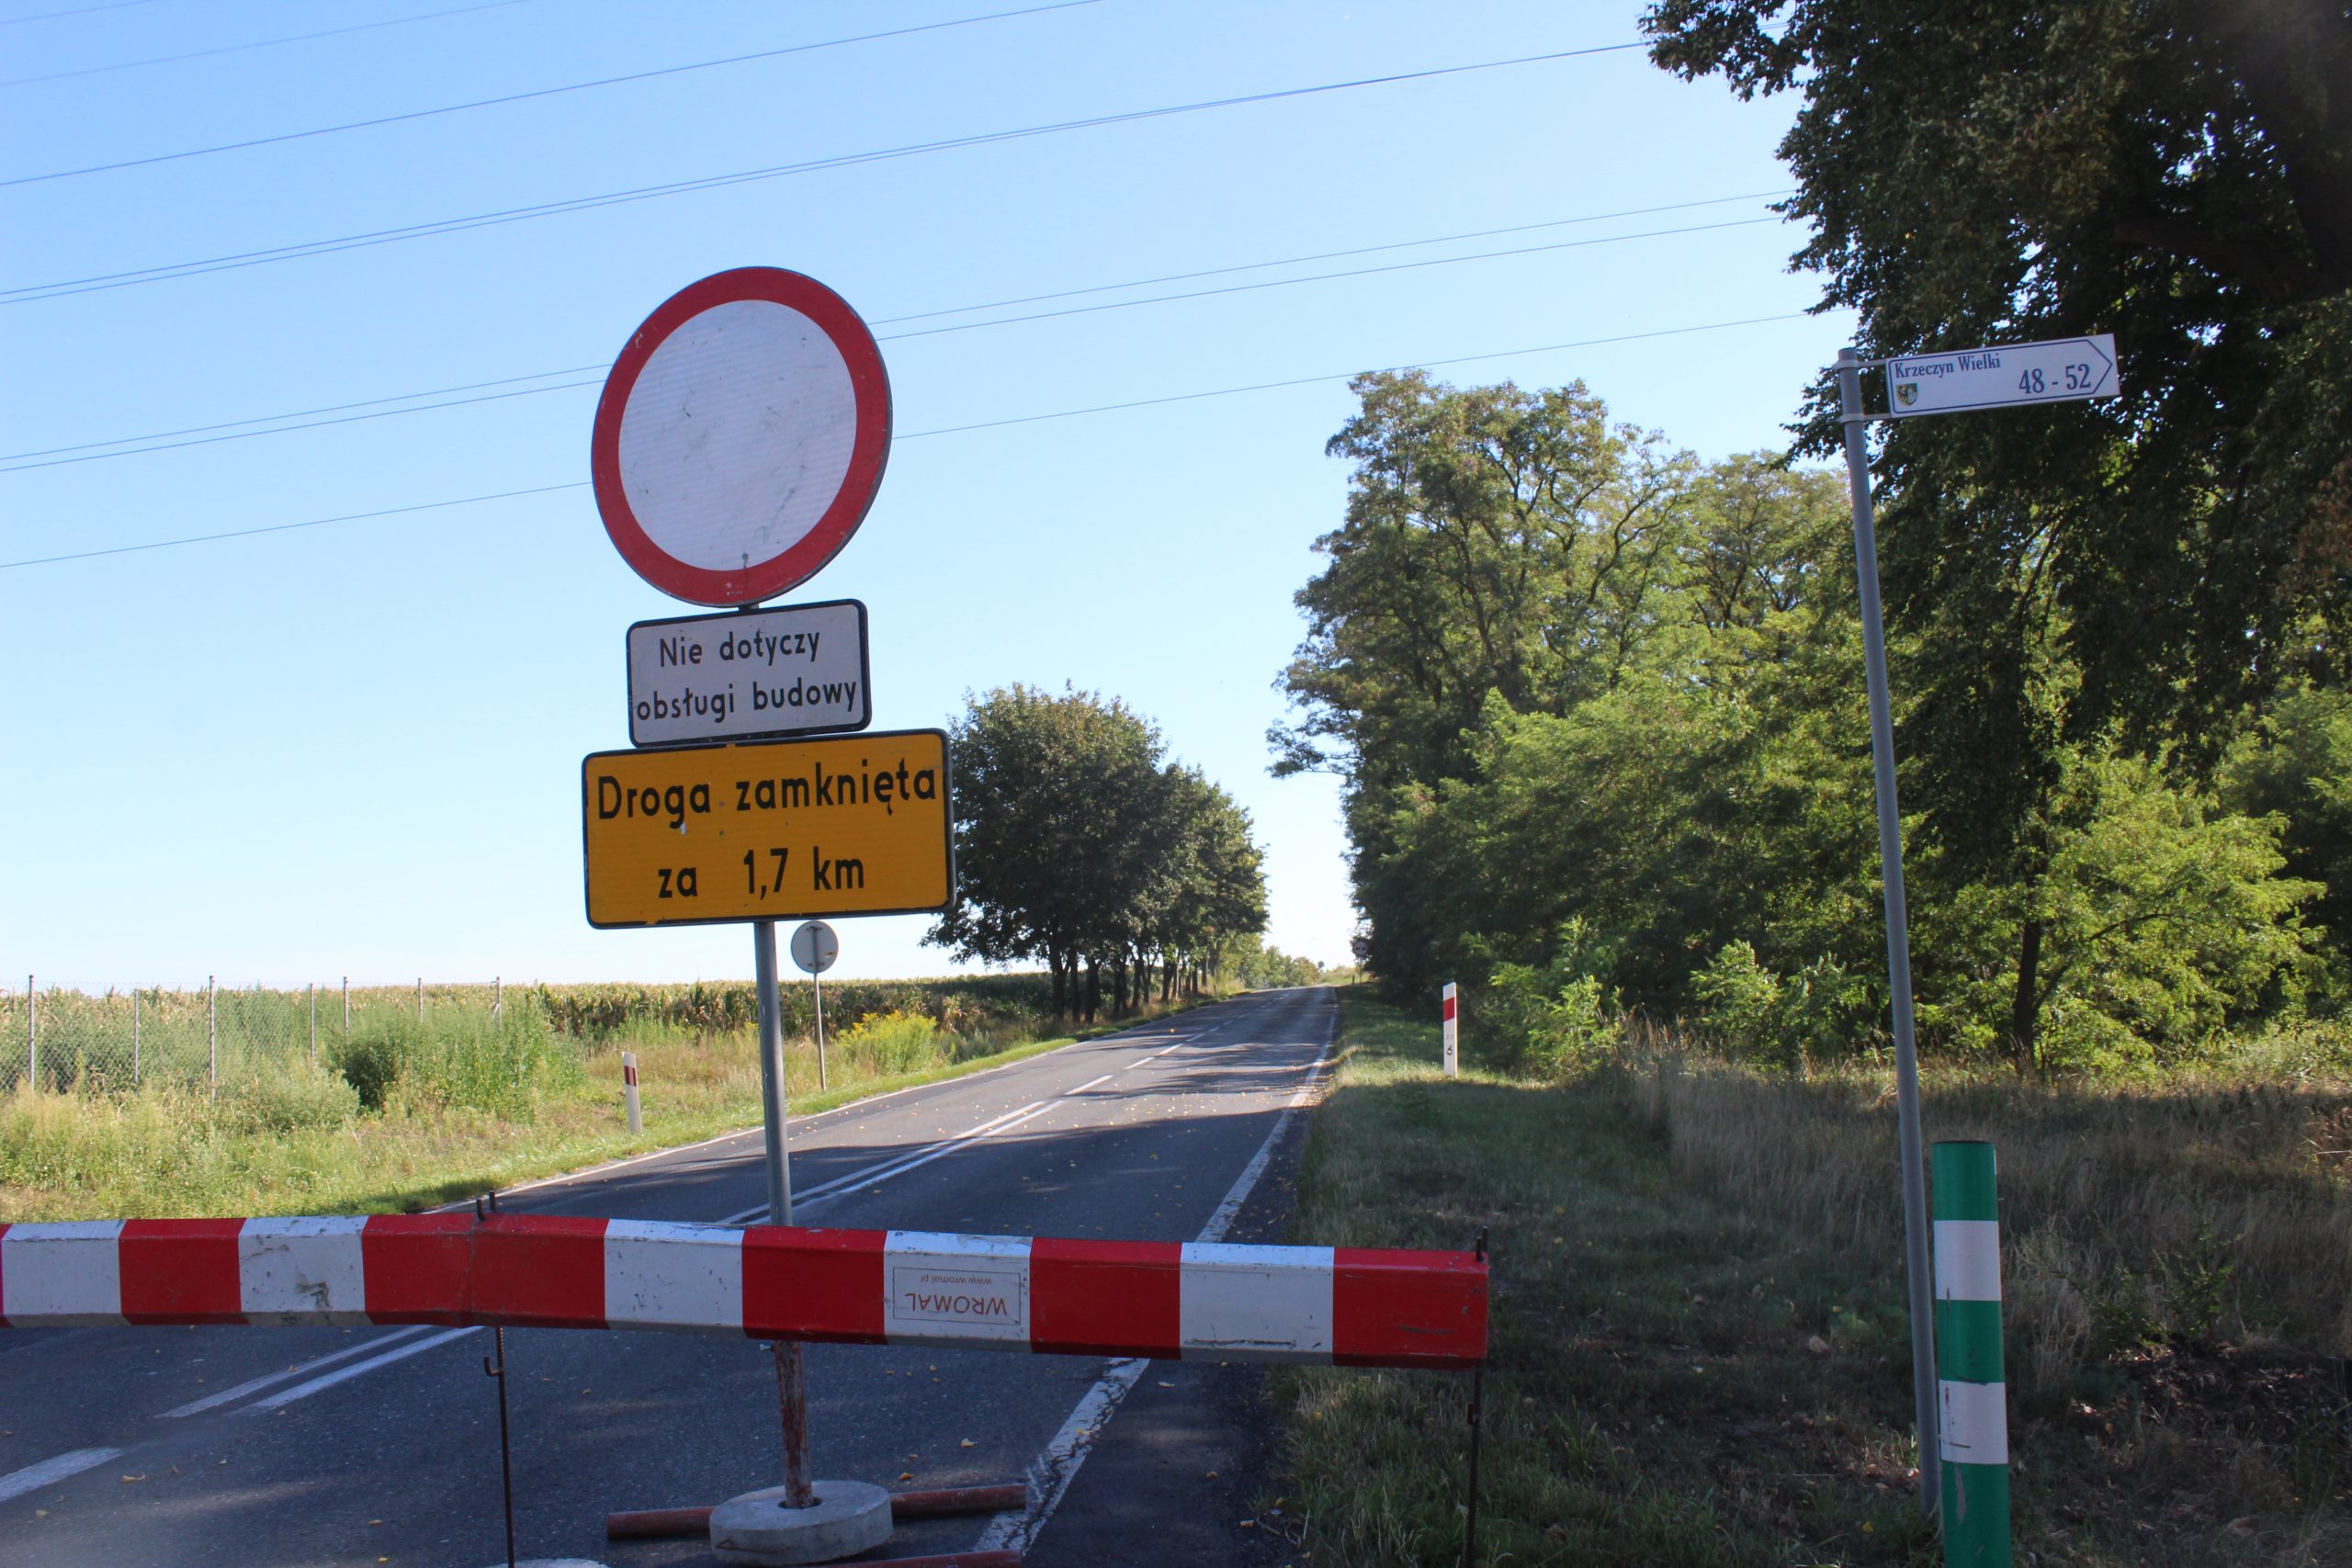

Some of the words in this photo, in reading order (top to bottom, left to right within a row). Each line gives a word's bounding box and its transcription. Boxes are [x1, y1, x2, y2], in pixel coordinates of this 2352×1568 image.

[1894, 361, 1954, 378] Krzeczyn
[1958, 353, 2000, 372] Wielki
[2018, 368, 2045, 394] 48
[2065, 364, 2091, 390] 52
[660, 637, 703, 668] Nie
[719, 629, 820, 666] dotyczy
[637, 683, 735, 724] obsługi
[752, 677, 857, 713] budowy
[597, 775, 711, 829] Droga
[736, 758, 936, 817] zamknięta
[658, 866, 698, 899] za
[743, 847, 788, 900] 1,7
[812, 845, 865, 891] km
[920, 1274, 992, 1286] www.wromal.pl
[904, 1292, 1008, 1317] WROMAL
